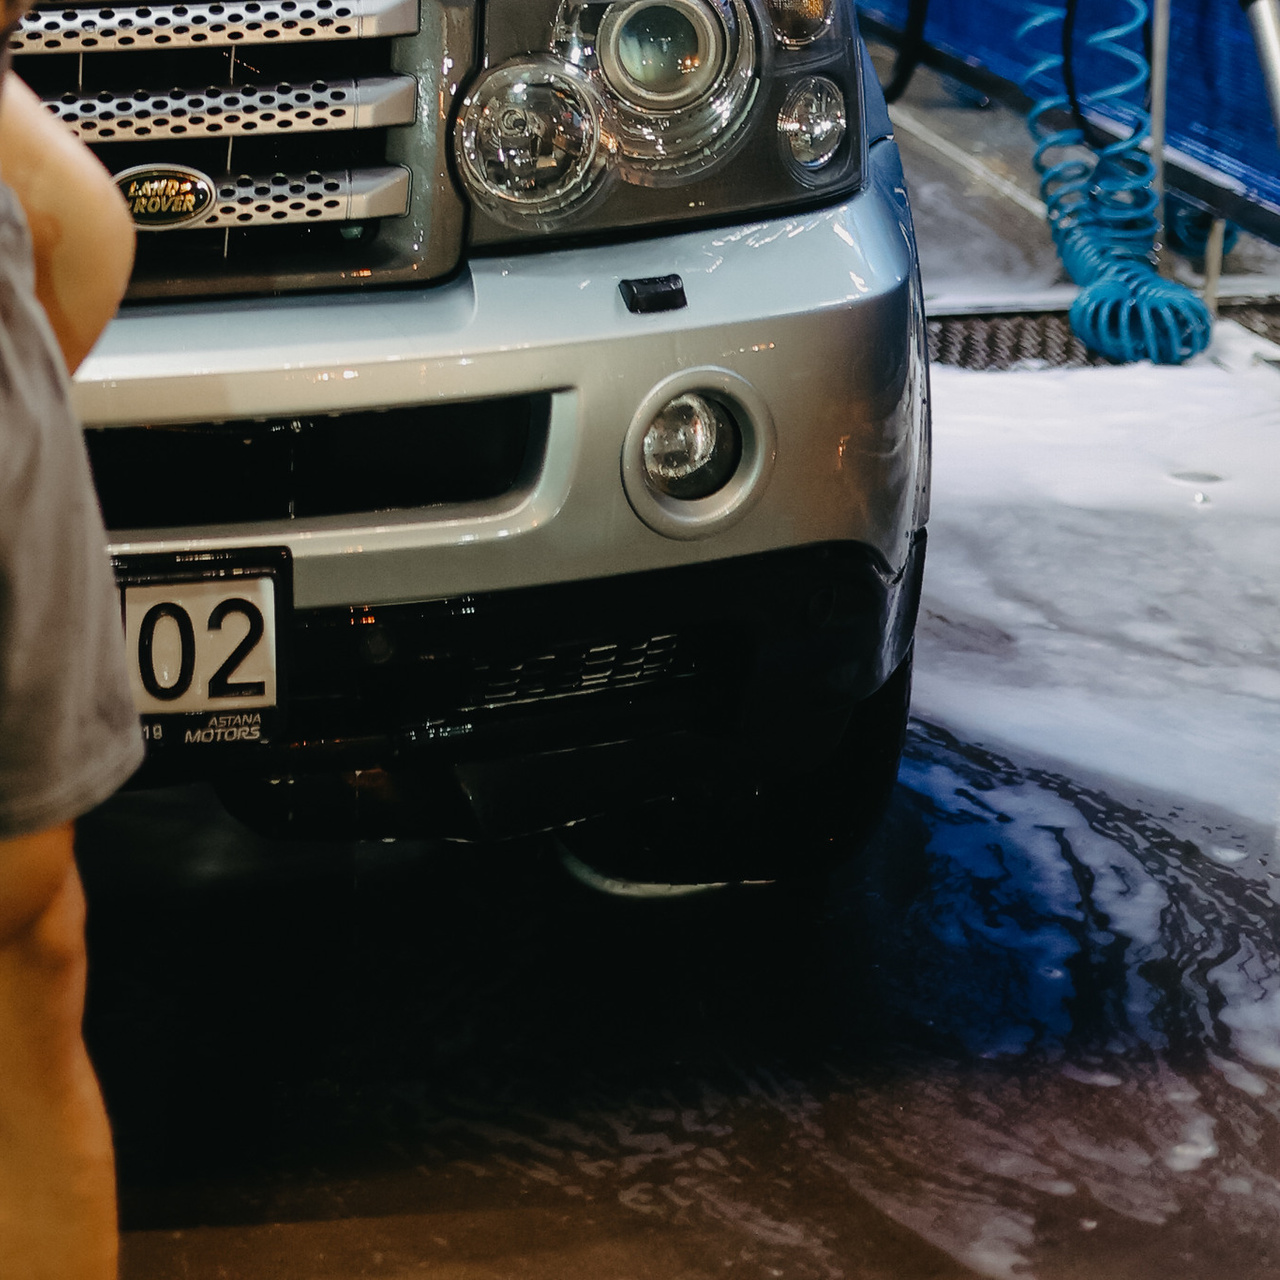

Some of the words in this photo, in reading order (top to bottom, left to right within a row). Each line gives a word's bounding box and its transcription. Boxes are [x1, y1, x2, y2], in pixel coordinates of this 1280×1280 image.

[128, 179, 179, 196] LAND
[133, 193, 196, 213] ROVER
[138, 598, 265, 700] 02
[208, 714, 261, 727] ASTANA
[185, 726, 261, 743] MOTORS
